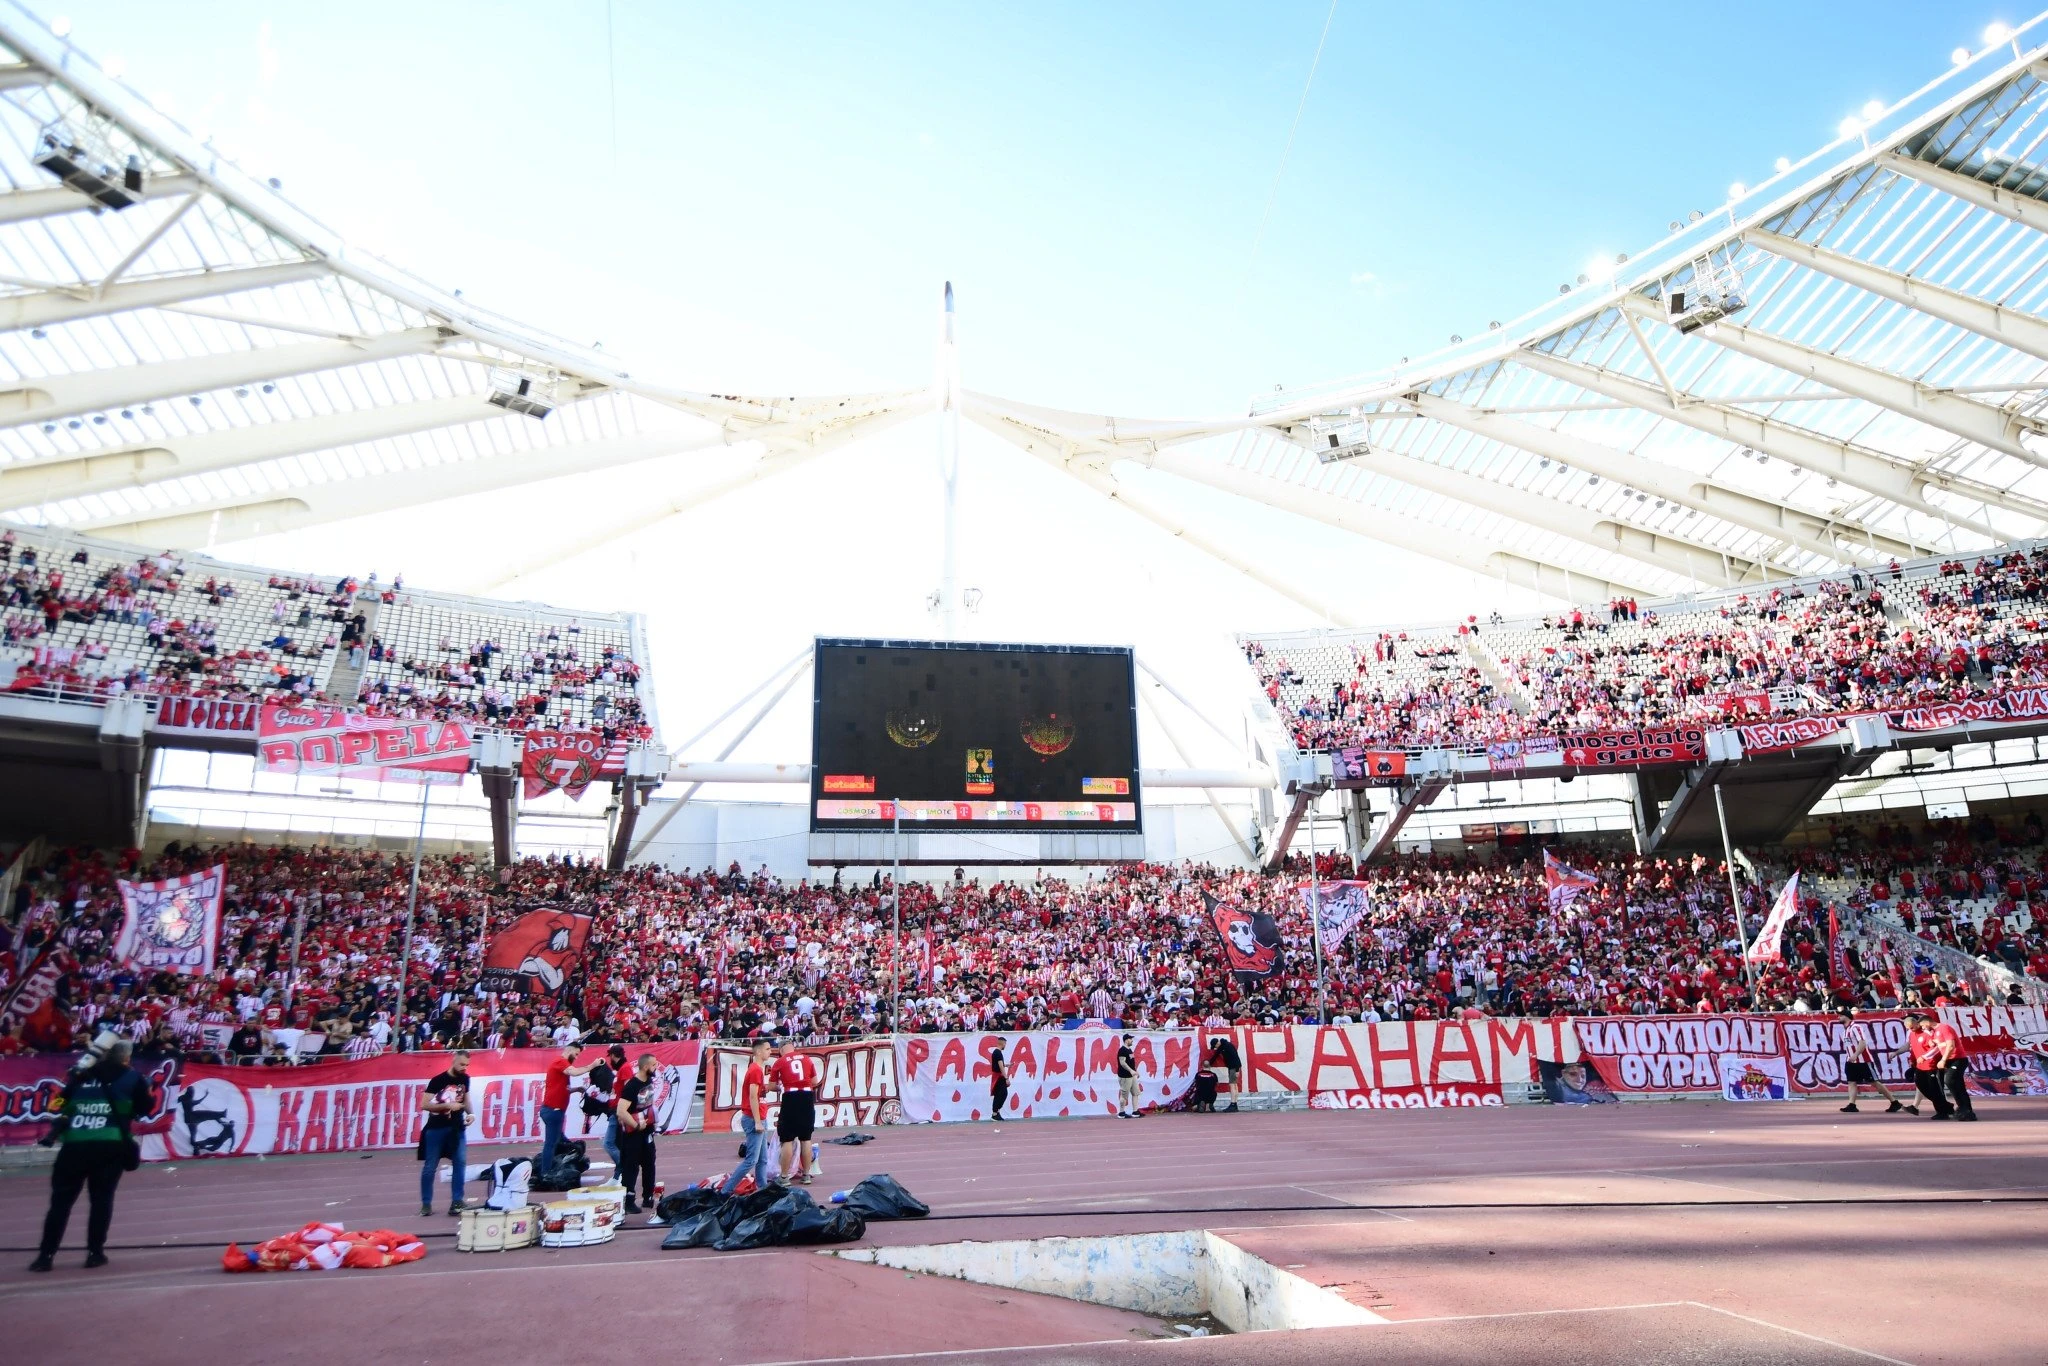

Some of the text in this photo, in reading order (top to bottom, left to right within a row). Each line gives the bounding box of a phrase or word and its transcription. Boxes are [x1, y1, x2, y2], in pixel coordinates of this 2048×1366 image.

[273, 709, 334, 728] Gate 7
[261, 722, 472, 776] ΒΟΡΕΙΑ
[528, 735, 608, 761] ARGOS
[1559, 728, 1703, 751] moschato
[1597, 748, 1673, 765] gate
[549, 759, 580, 788] 7
[1577, 1018, 1777, 1055] ΗΛΙΟΥΠΟΛΗ
[790, 1060, 804, 1081] 9
[482, 1079, 546, 1139] GAT
[1328, 1085, 1504, 1110] Nafpaktos
